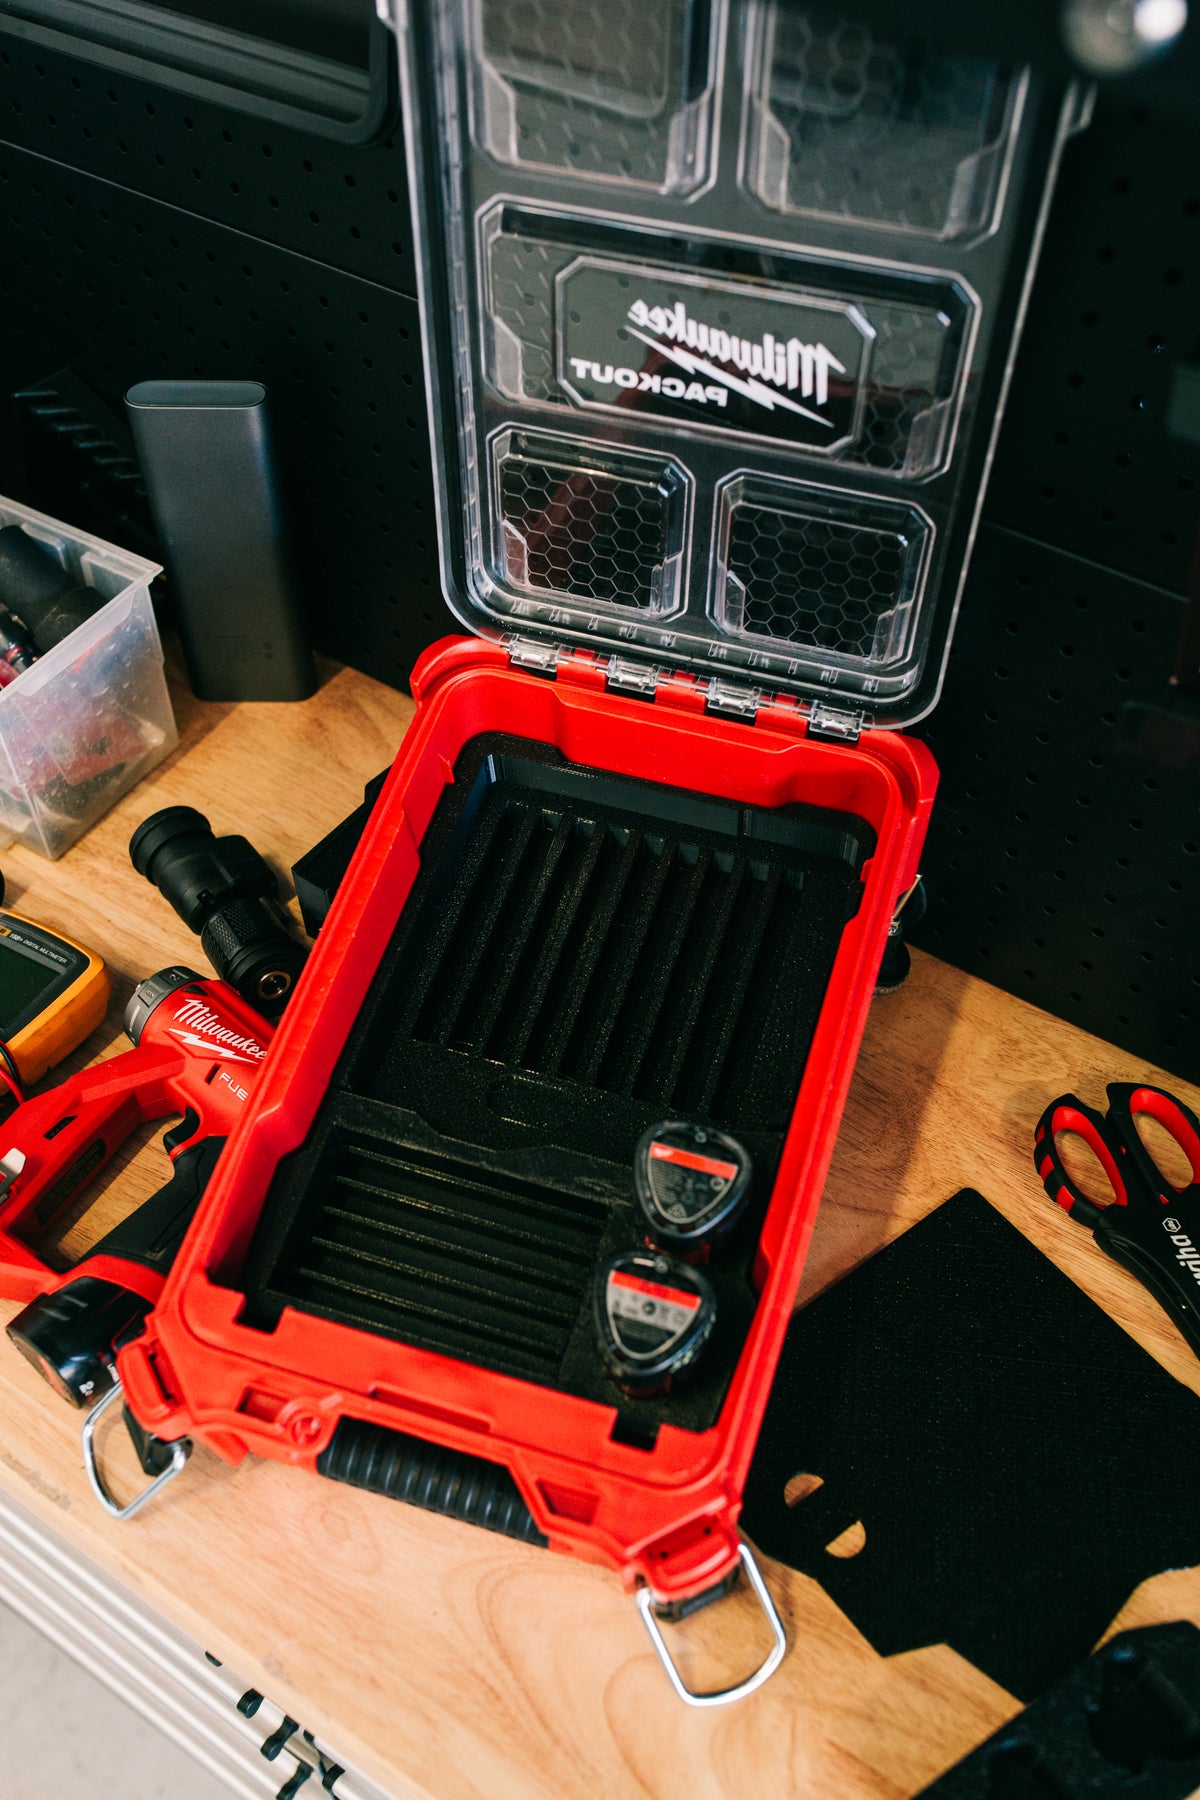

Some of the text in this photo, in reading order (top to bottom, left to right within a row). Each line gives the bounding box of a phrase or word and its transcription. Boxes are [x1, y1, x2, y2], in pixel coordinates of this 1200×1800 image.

[23, 940, 40, 950] DIGITAL
[40, 947, 68, 963] MULTIMETER
[173, 998, 268, 1060] Milwaukee
[219, 1072, 249, 1101] FUE
